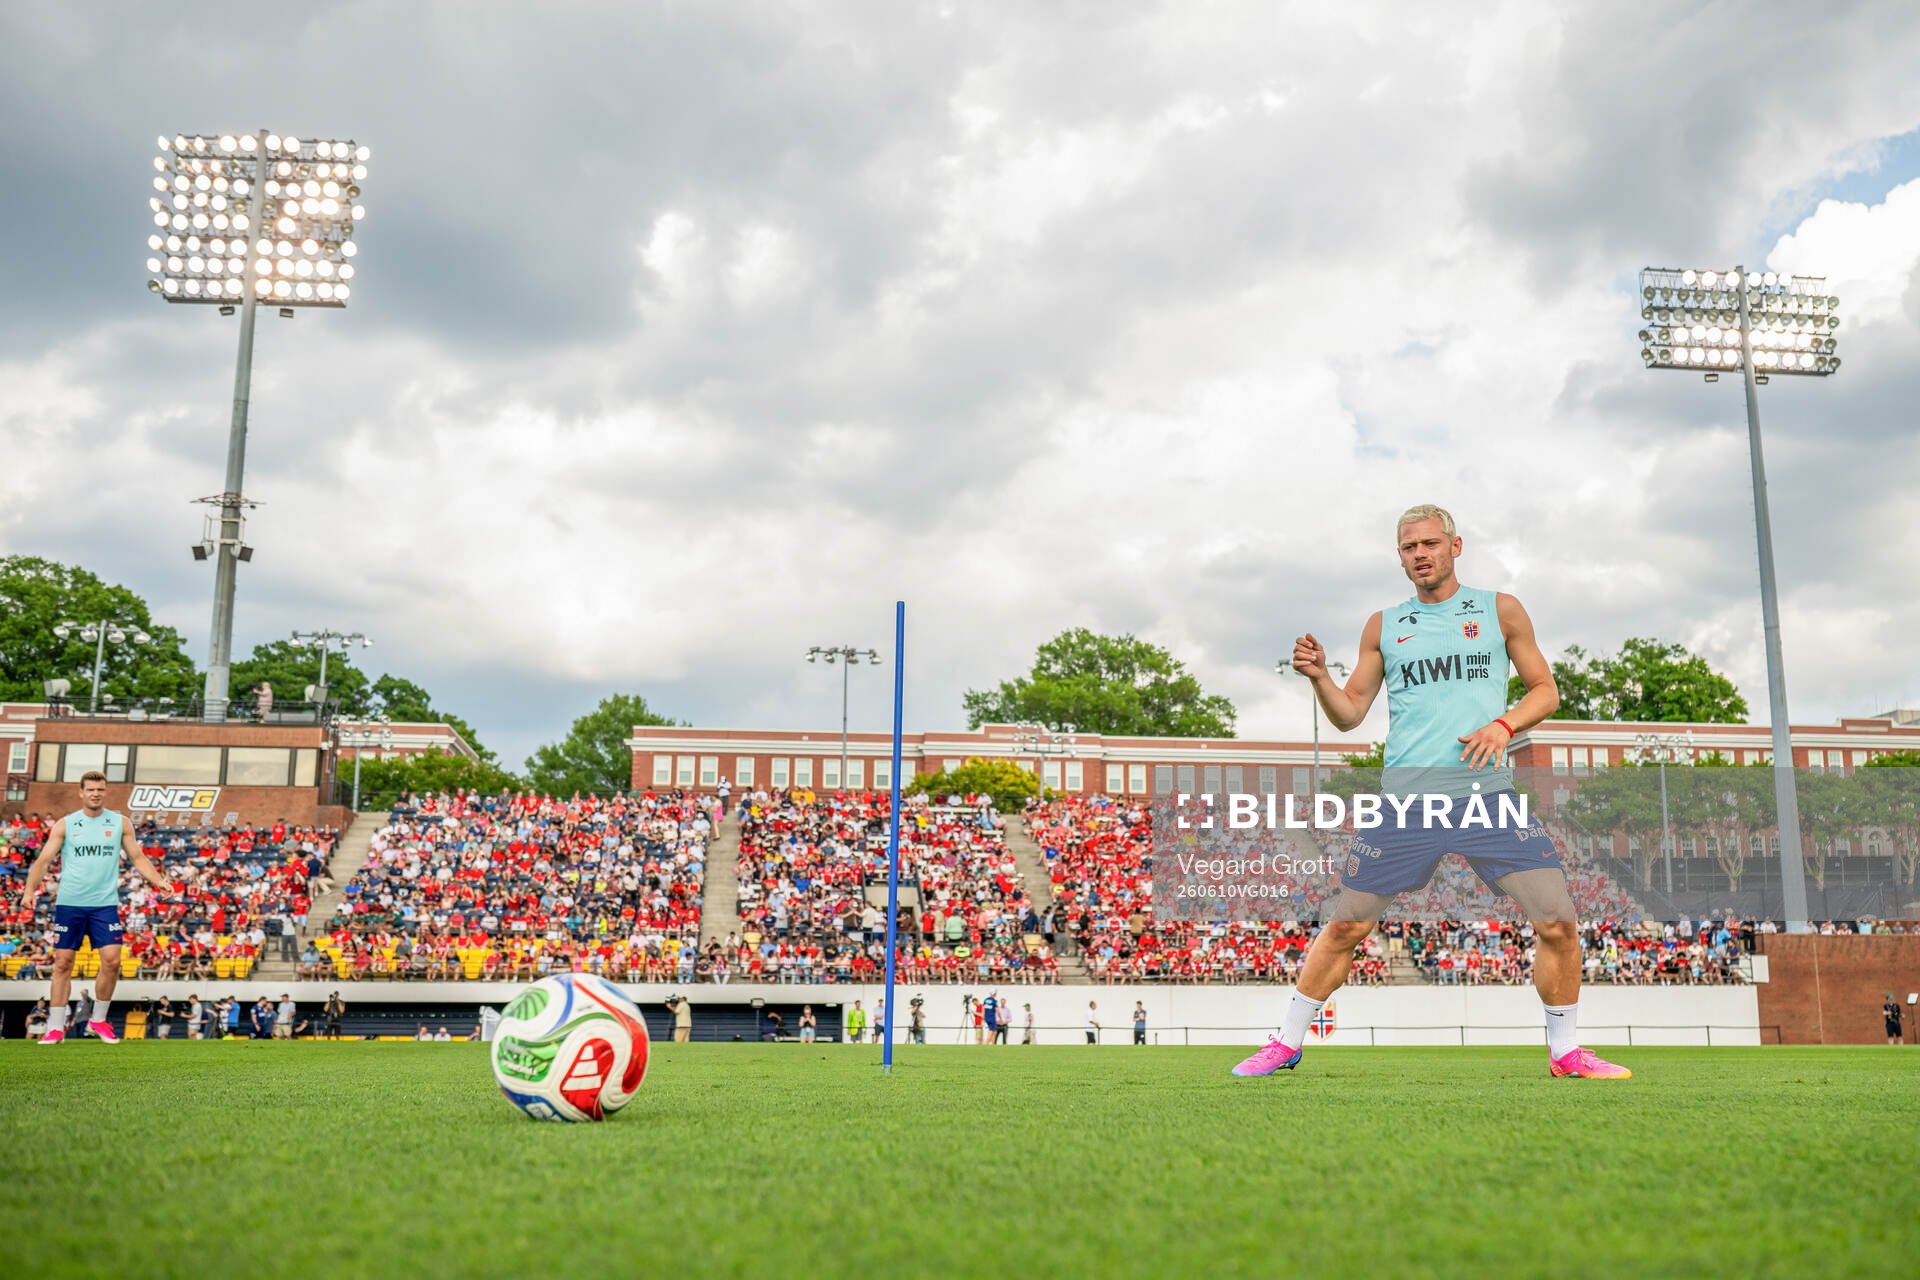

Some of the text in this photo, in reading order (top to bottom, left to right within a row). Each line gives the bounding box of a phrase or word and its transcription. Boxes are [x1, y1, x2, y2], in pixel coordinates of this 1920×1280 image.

[1466, 652, 1491, 665] mini
[1400, 654, 1462, 688] KIWI
[1467, 665, 1489, 681] pris
[129, 786, 218, 810] UNCG
[114, 810, 240, 827] OCCER
[74, 845, 101, 857] KIWI
